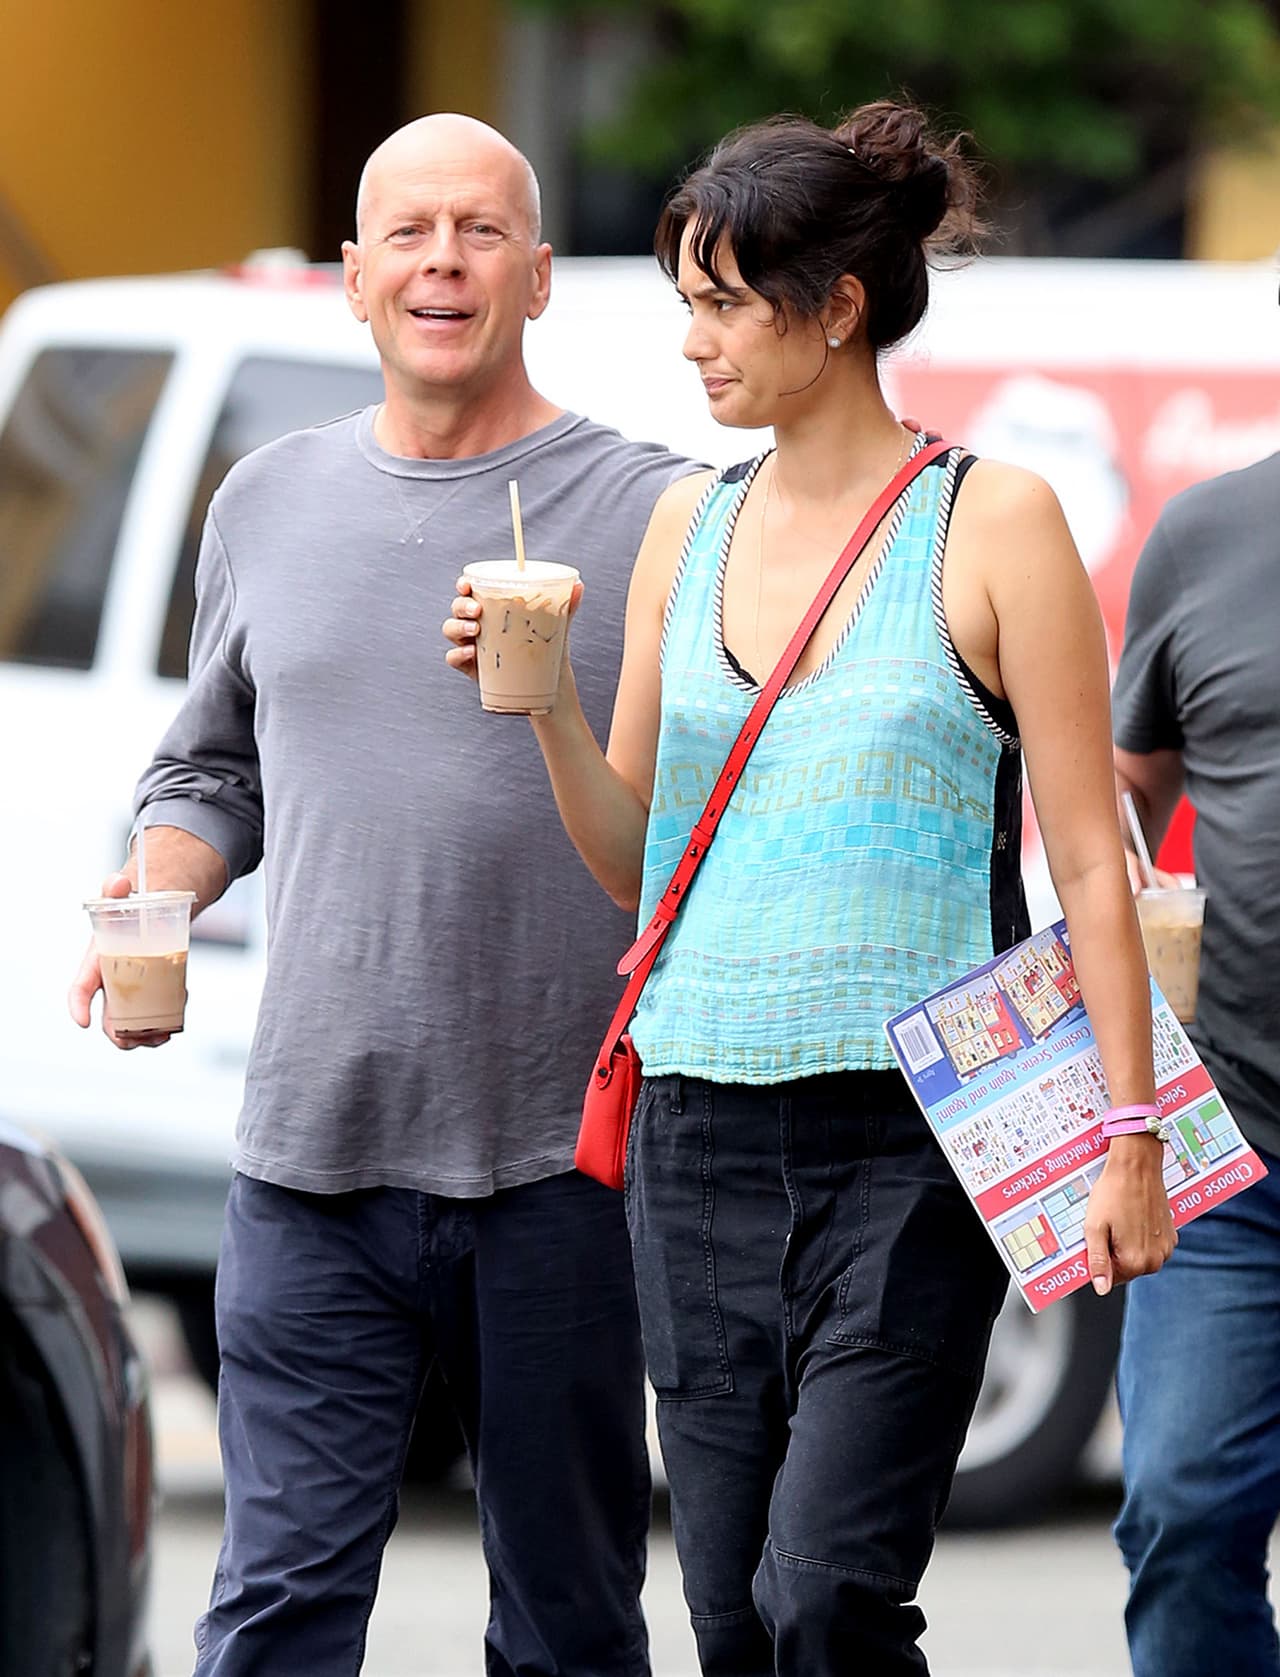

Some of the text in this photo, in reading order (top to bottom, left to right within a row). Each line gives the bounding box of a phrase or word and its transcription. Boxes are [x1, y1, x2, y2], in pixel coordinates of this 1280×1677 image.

[1051, 1025, 1092, 1053] Custom
[988, 1068, 1018, 1090] Again
[967, 1085, 988, 1105] and
[935, 1096, 969, 1123] Again!
[1092, 1131, 1106, 1150] of
[1044, 1139, 1093, 1173] Matching
[1002, 1166, 1048, 1199] Stickers
[1203, 1162, 1253, 1197] Choose
[1176, 1191, 1202, 1213] one
